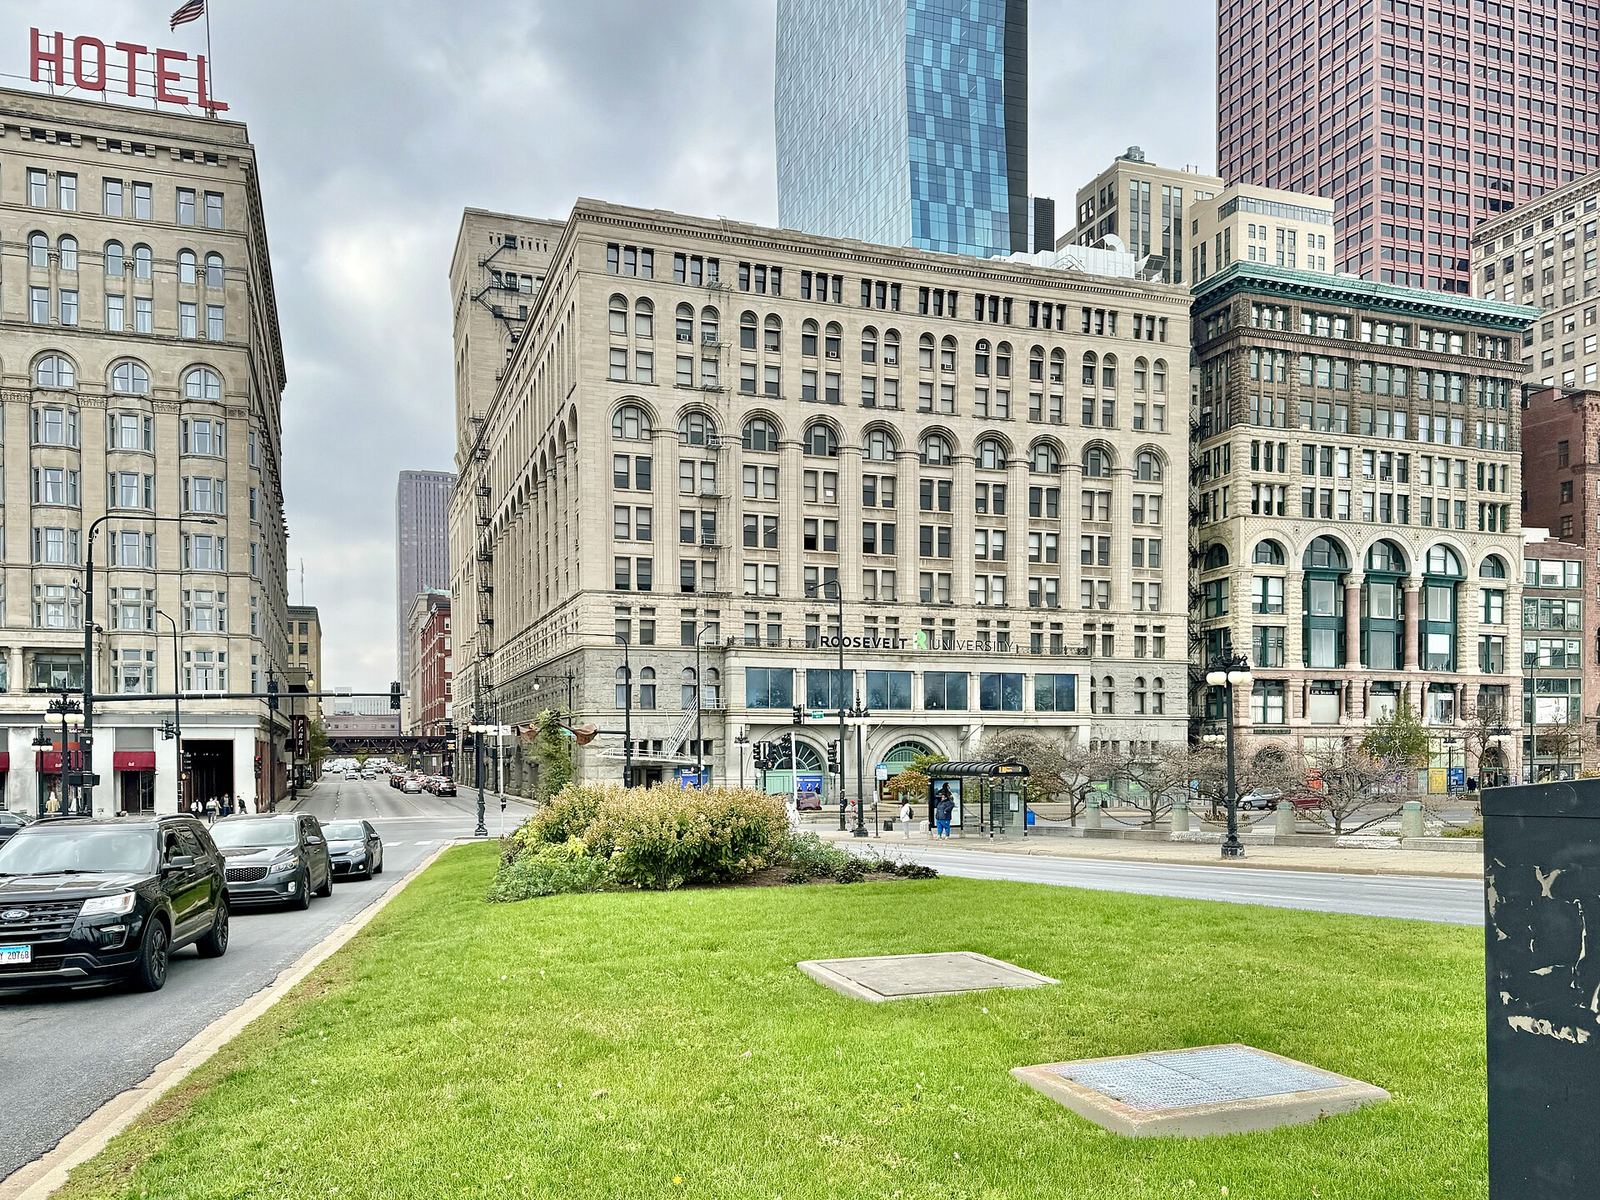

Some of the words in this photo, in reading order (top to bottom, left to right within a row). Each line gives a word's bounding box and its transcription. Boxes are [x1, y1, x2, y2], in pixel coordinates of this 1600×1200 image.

[30, 27, 229, 111] HOTEL
[820, 636, 908, 650] ROOSEVELT
[932, 639, 1014, 652] UNIVERSITY
